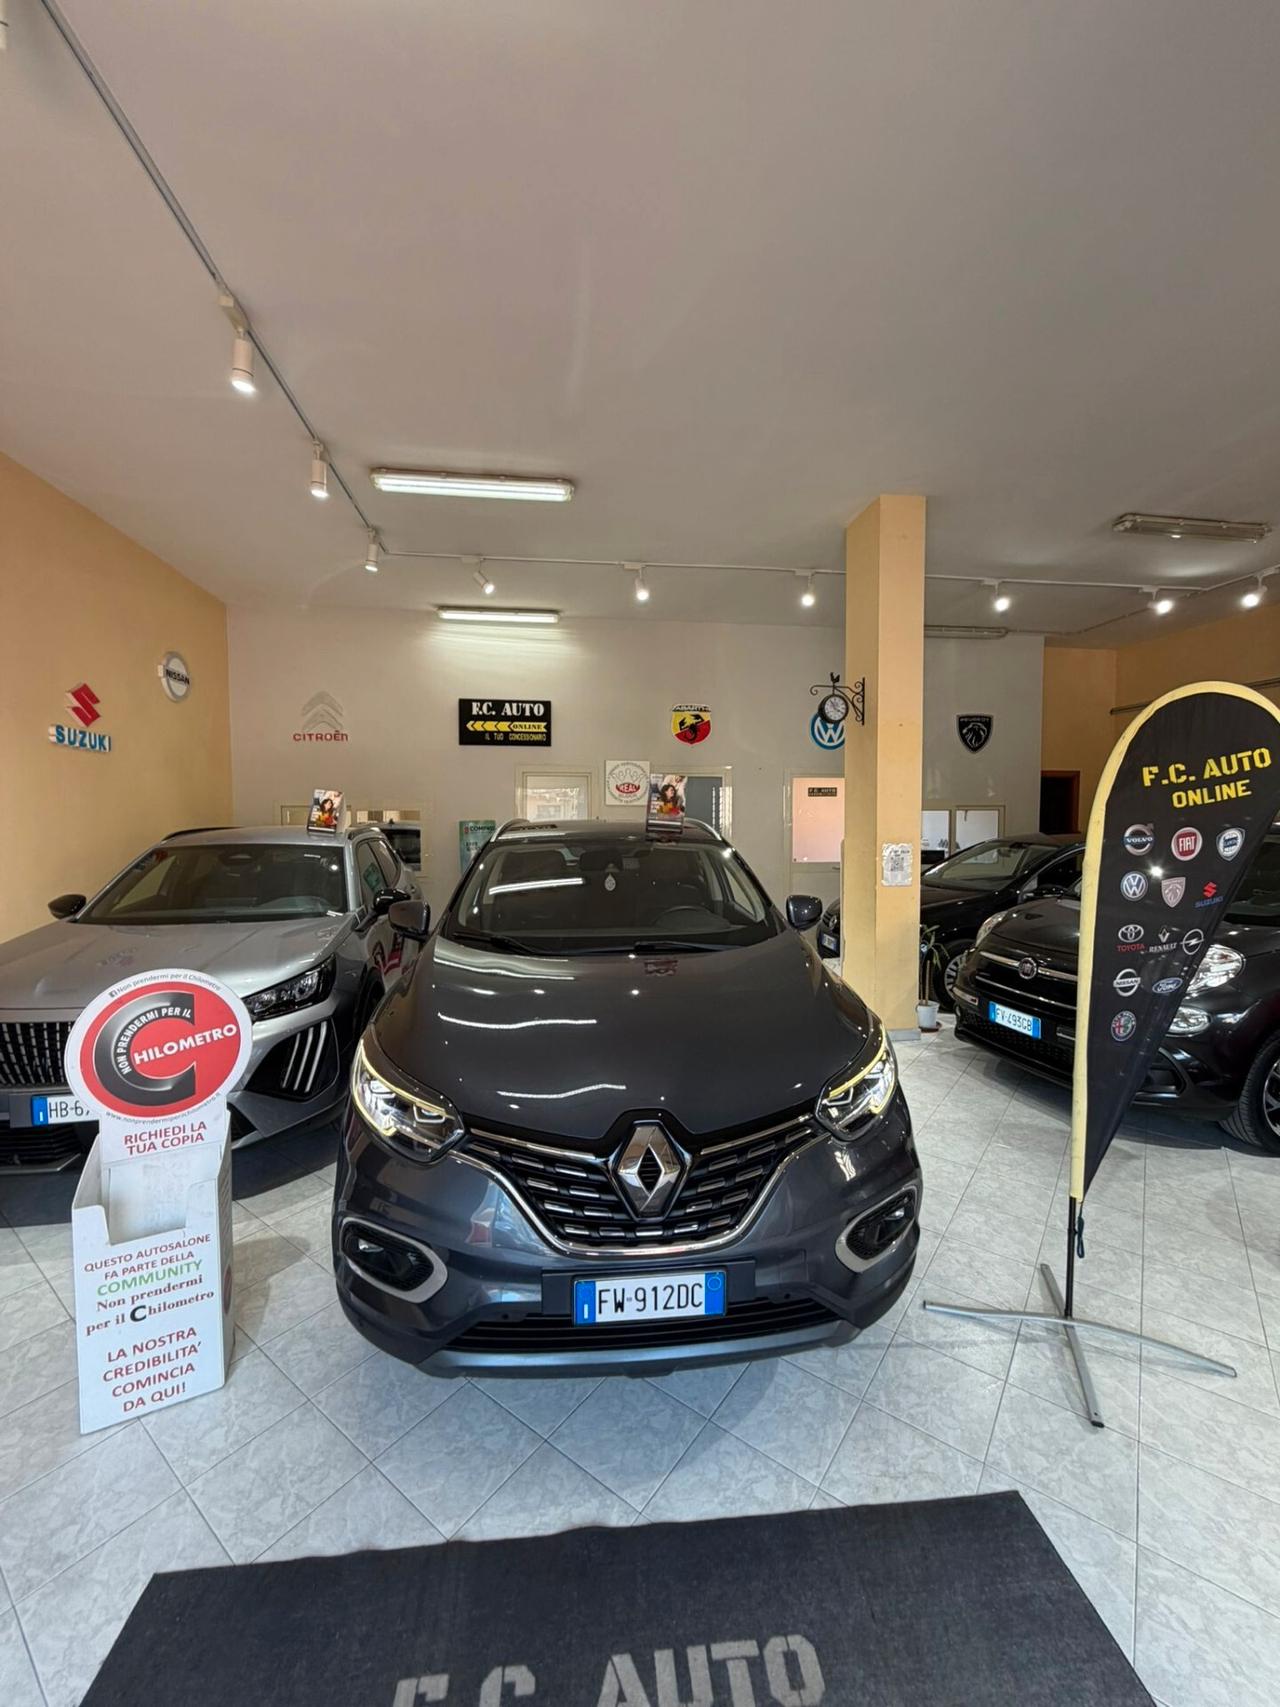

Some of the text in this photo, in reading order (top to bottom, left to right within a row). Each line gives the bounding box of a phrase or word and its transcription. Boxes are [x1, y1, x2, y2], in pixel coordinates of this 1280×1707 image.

[166, 669, 190, 685] NISSAN
[471, 702, 544, 716] F.C. AUTO
[53, 724, 112, 752] SUZUKI
[1142, 747, 1271, 787] F.C. AUTO
[1172, 779, 1252, 808] ONLINE
[1178, 836, 1196, 852] FIAT
[1116, 943, 1146, 952] TOYOTA
[1149, 942, 1178, 952] RENAULT
[117, 1007, 191, 1074] NON PRENDERMI PER IL
[124, 1121, 207, 1145] RICHIEDI LA
[127, 1132, 205, 1155] TUA COPIA
[84, 1234, 211, 1273] QUESTO AUTOSALONE
[104, 1251, 194, 1280] FA PARTE DELLA
[96, 1274, 203, 1312] Non prendermi
[97, 1260, 203, 1297] COMMUNITY
[86, 1290, 214, 1336] per il Chilometro
[107, 1327, 197, 1363] LA NOSTRA
[112, 1362, 195, 1397] COMINCIA
[123, 1382, 186, 1412] DA QUI!
[597, 1634, 825, 1707] AUTO
